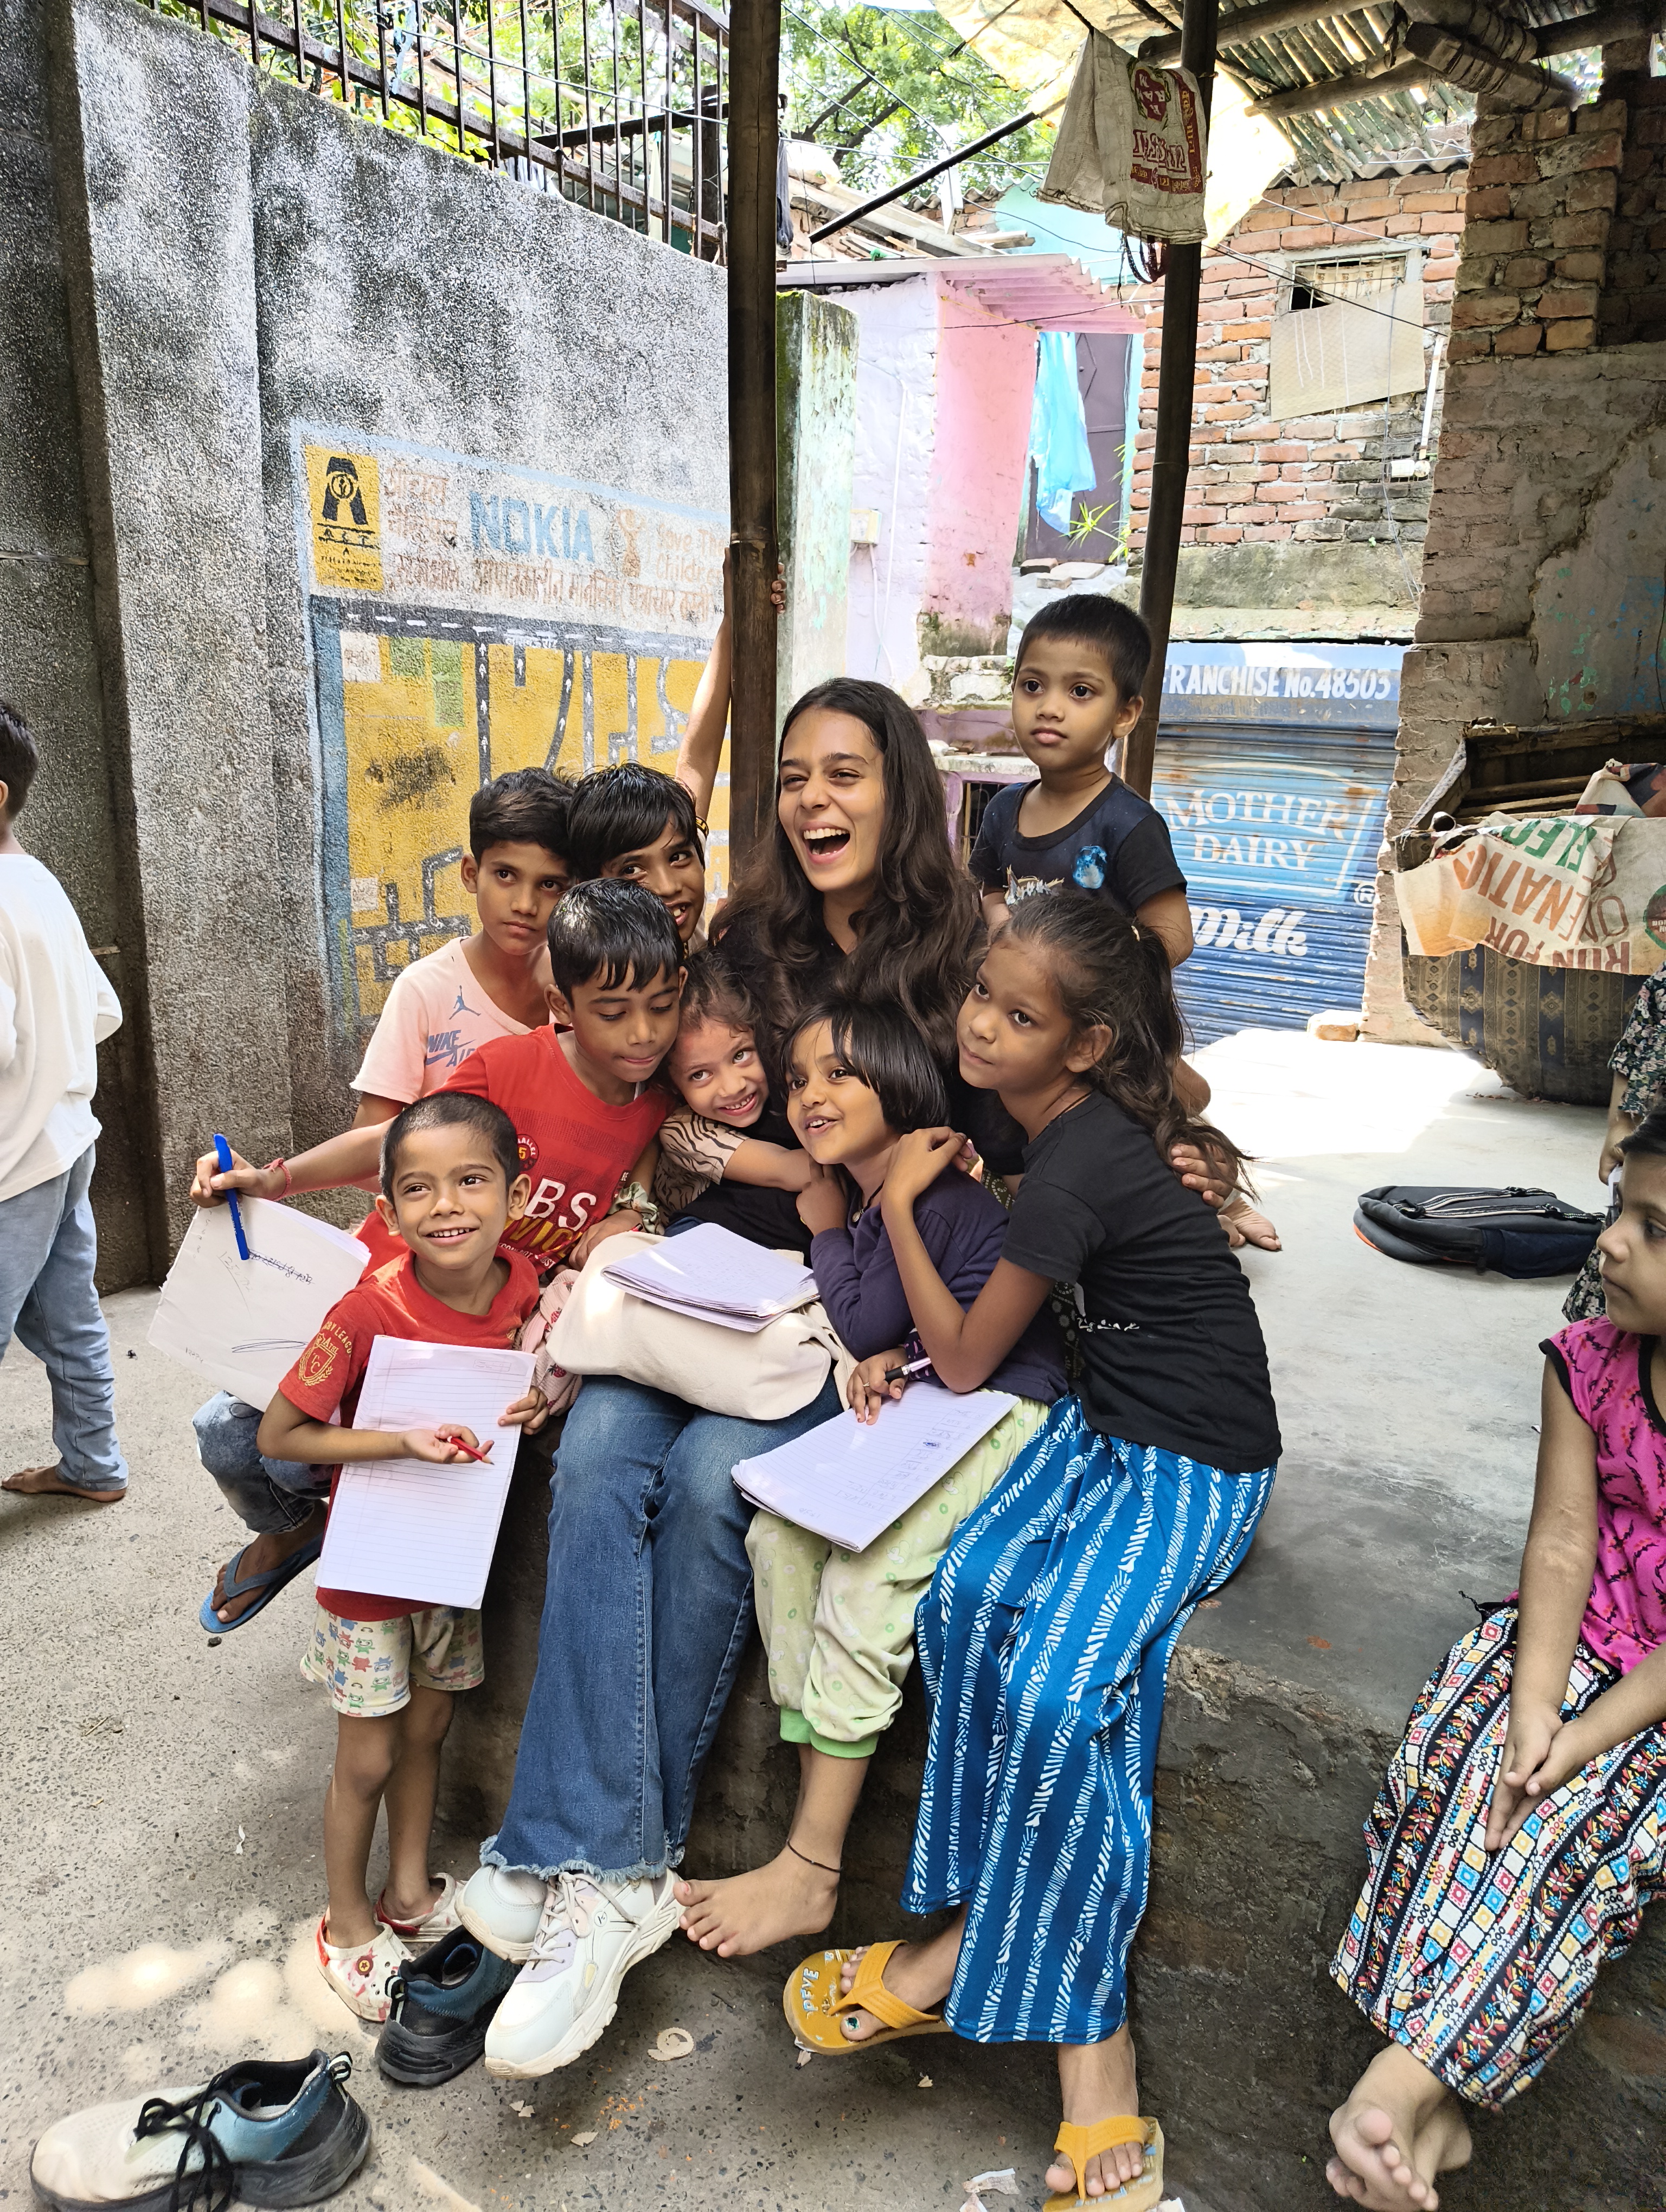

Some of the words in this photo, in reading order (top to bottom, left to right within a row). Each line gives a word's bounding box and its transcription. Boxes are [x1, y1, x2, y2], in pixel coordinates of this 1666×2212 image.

[469, 490, 595, 563] NOKIA
[1162, 788, 1349, 842] MOTHER
[1194, 834, 1317, 871] DAIRY
[428, 1030, 462, 1053] NIKE
[519, 1147, 527, 1159] 5
